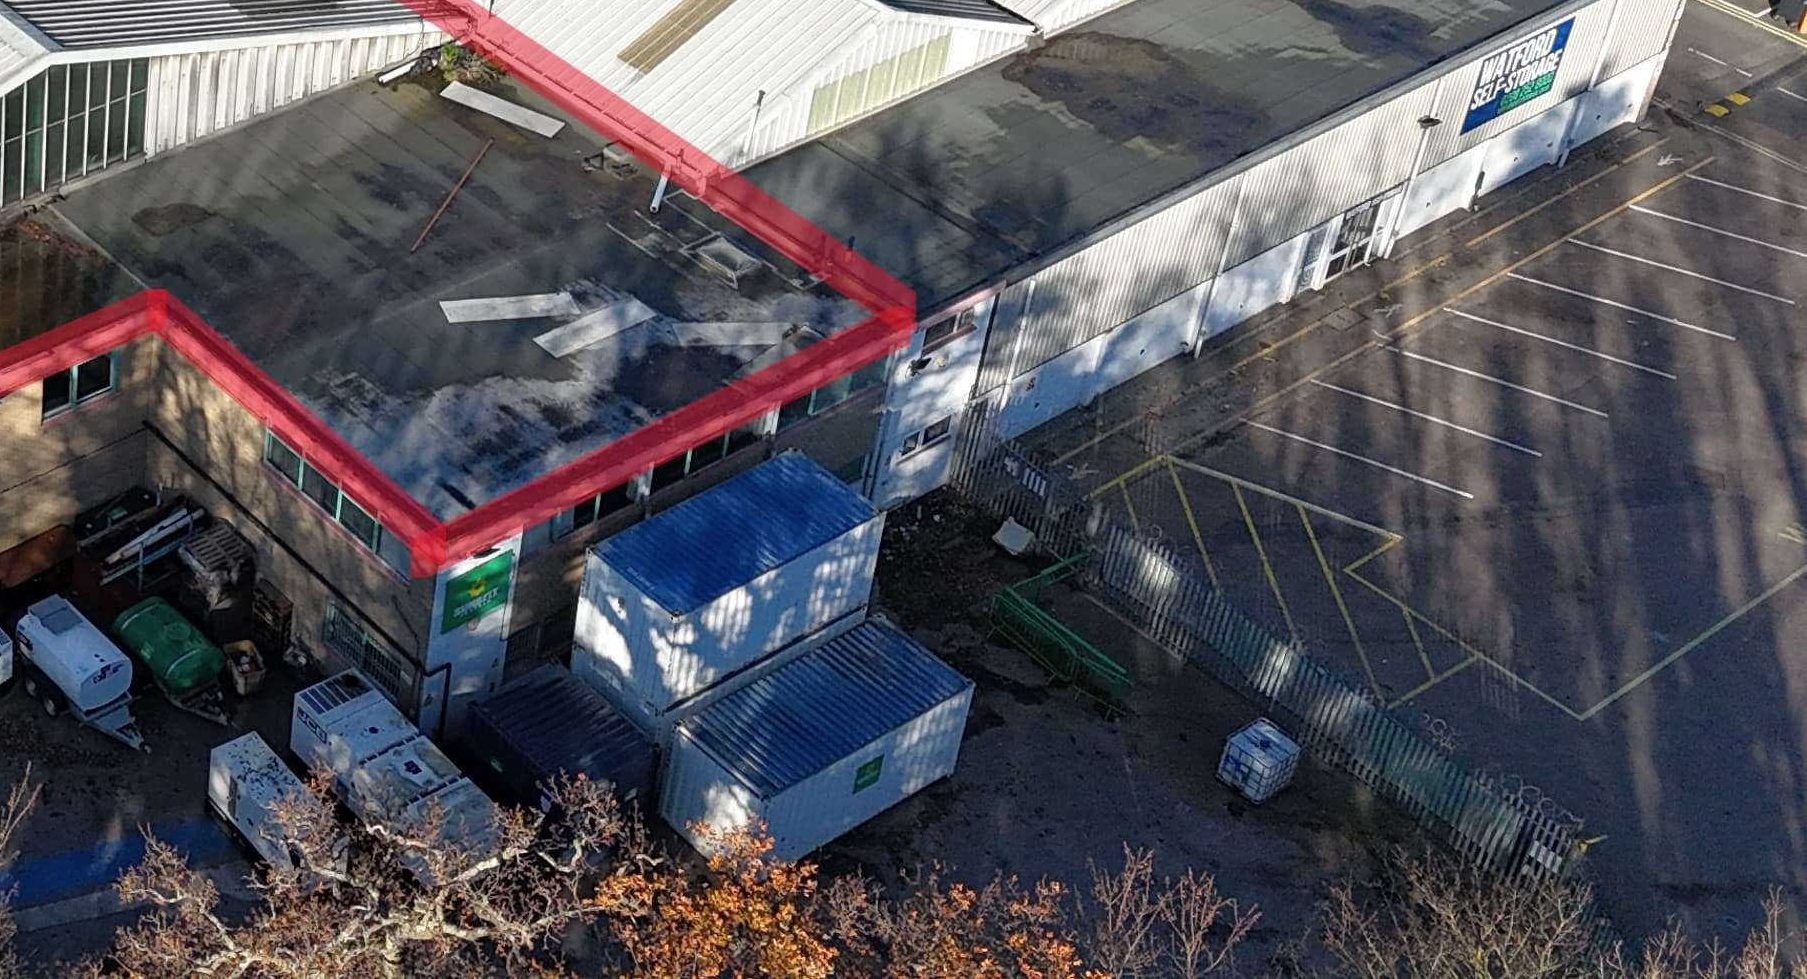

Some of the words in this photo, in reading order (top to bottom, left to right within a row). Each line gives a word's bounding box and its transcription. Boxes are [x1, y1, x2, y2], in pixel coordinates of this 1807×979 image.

[1470, 48, 1563, 110] SELF-STORAGE
[1479, 28, 1557, 87] WATFORD
[297, 706, 327, 744] JCB
